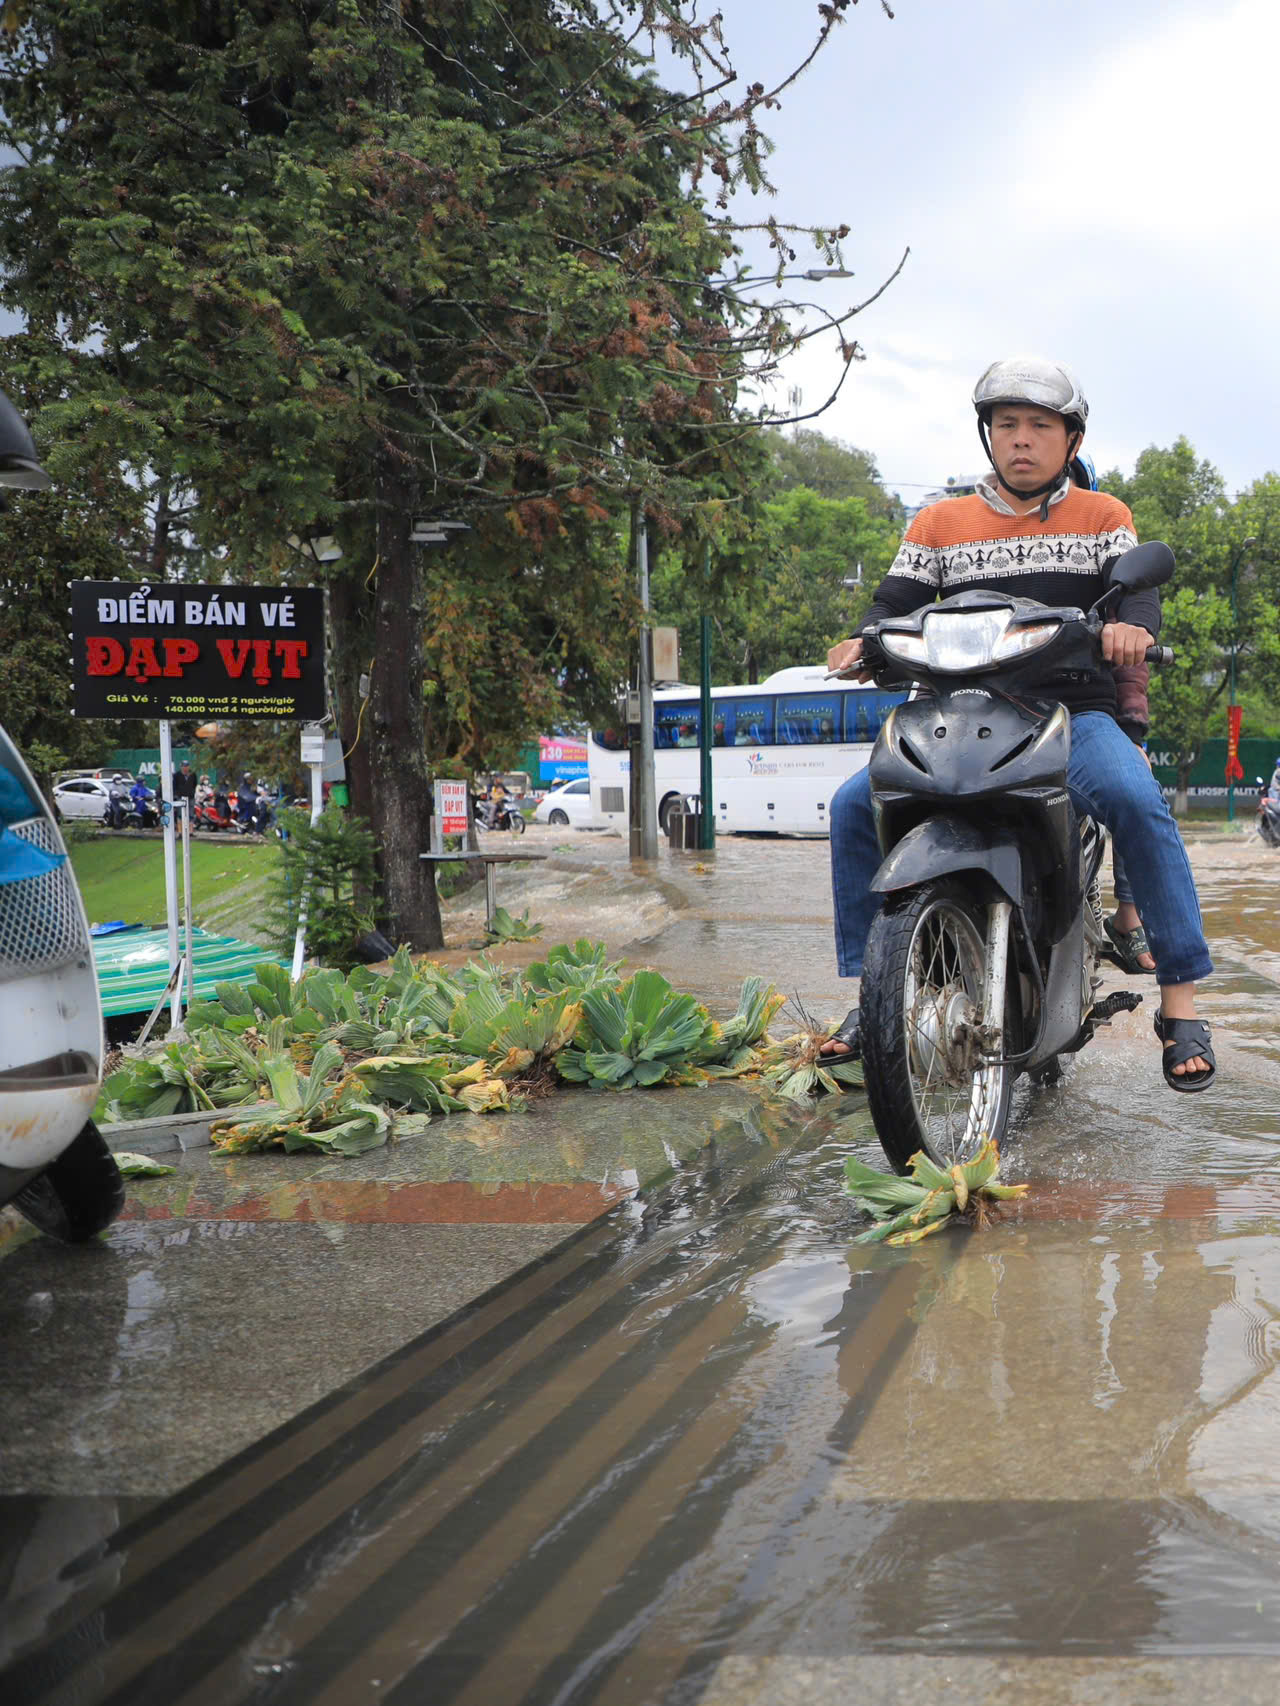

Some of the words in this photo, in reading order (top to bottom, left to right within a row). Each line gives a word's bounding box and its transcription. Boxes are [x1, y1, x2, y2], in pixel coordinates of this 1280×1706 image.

[98, 586, 175, 624] ĐIỂM
[185, 594, 246, 625] BÁN
[260, 596, 296, 627] VÉ
[85, 637, 199, 684] ĐẠP
[216, 639, 308, 686] VỊT
[950, 688, 993, 699] HONDA
[106, 694, 128, 703] Giá
[132, 694, 149, 703] Vé
[170, 696, 205, 704] 70.000
[208, 696, 229, 704] vnđ
[164, 705, 206, 713] 140.000
[208, 705, 229, 713] vnđ
[1198, 787, 1259, 796] HOSPIALITY
